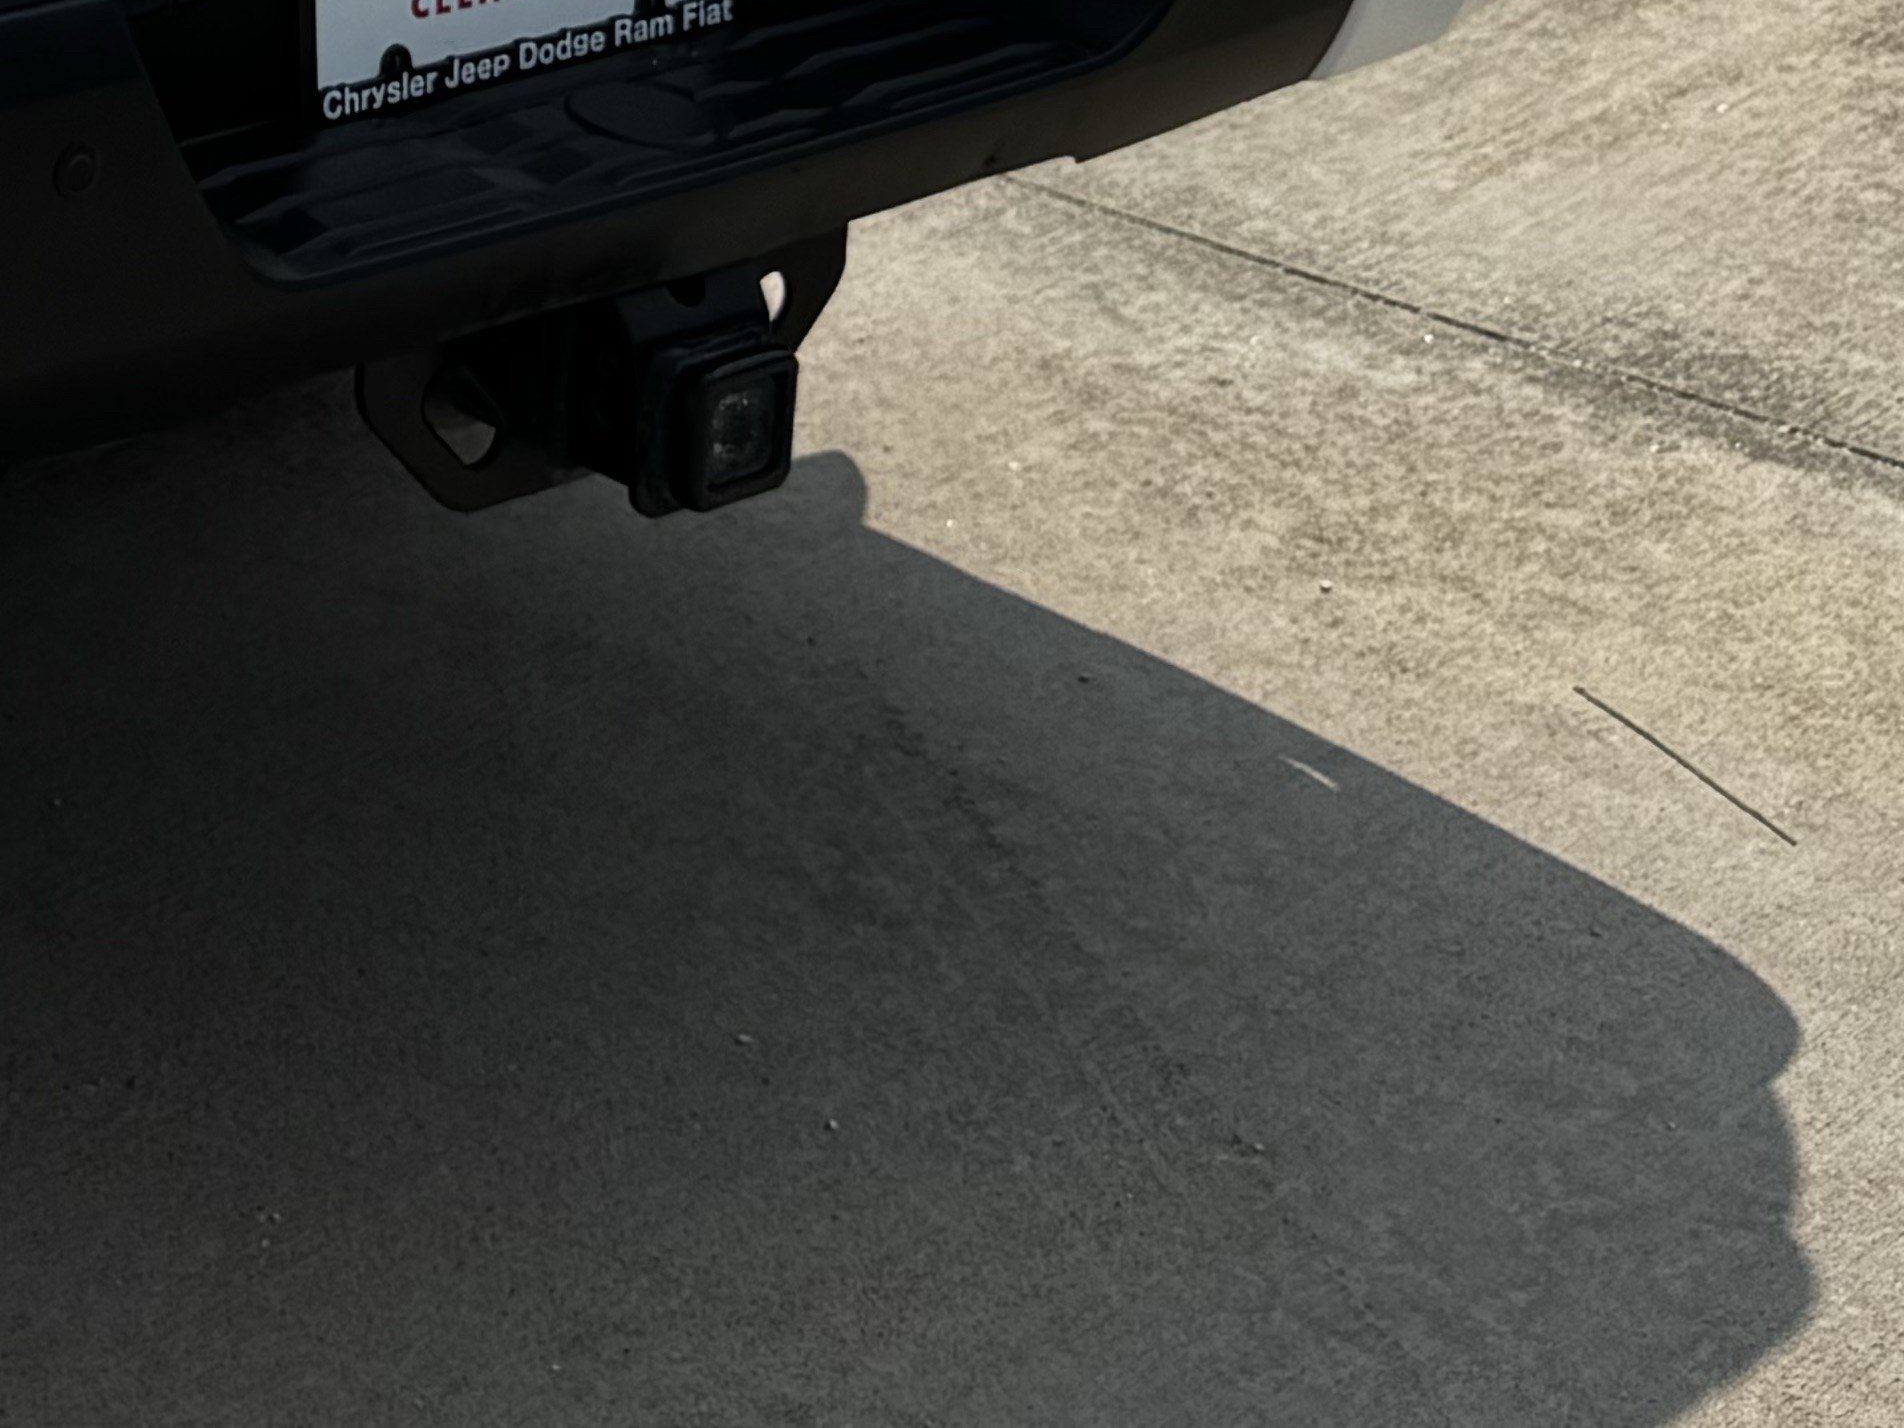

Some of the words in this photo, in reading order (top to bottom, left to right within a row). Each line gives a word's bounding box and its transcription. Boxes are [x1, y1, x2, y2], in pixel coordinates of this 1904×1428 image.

[323, 70, 435, 120] Chrysler
[445, 55, 510, 89] Jeep
[519, 30, 605, 69] Dodge
[614, 12, 674, 46] Ram
